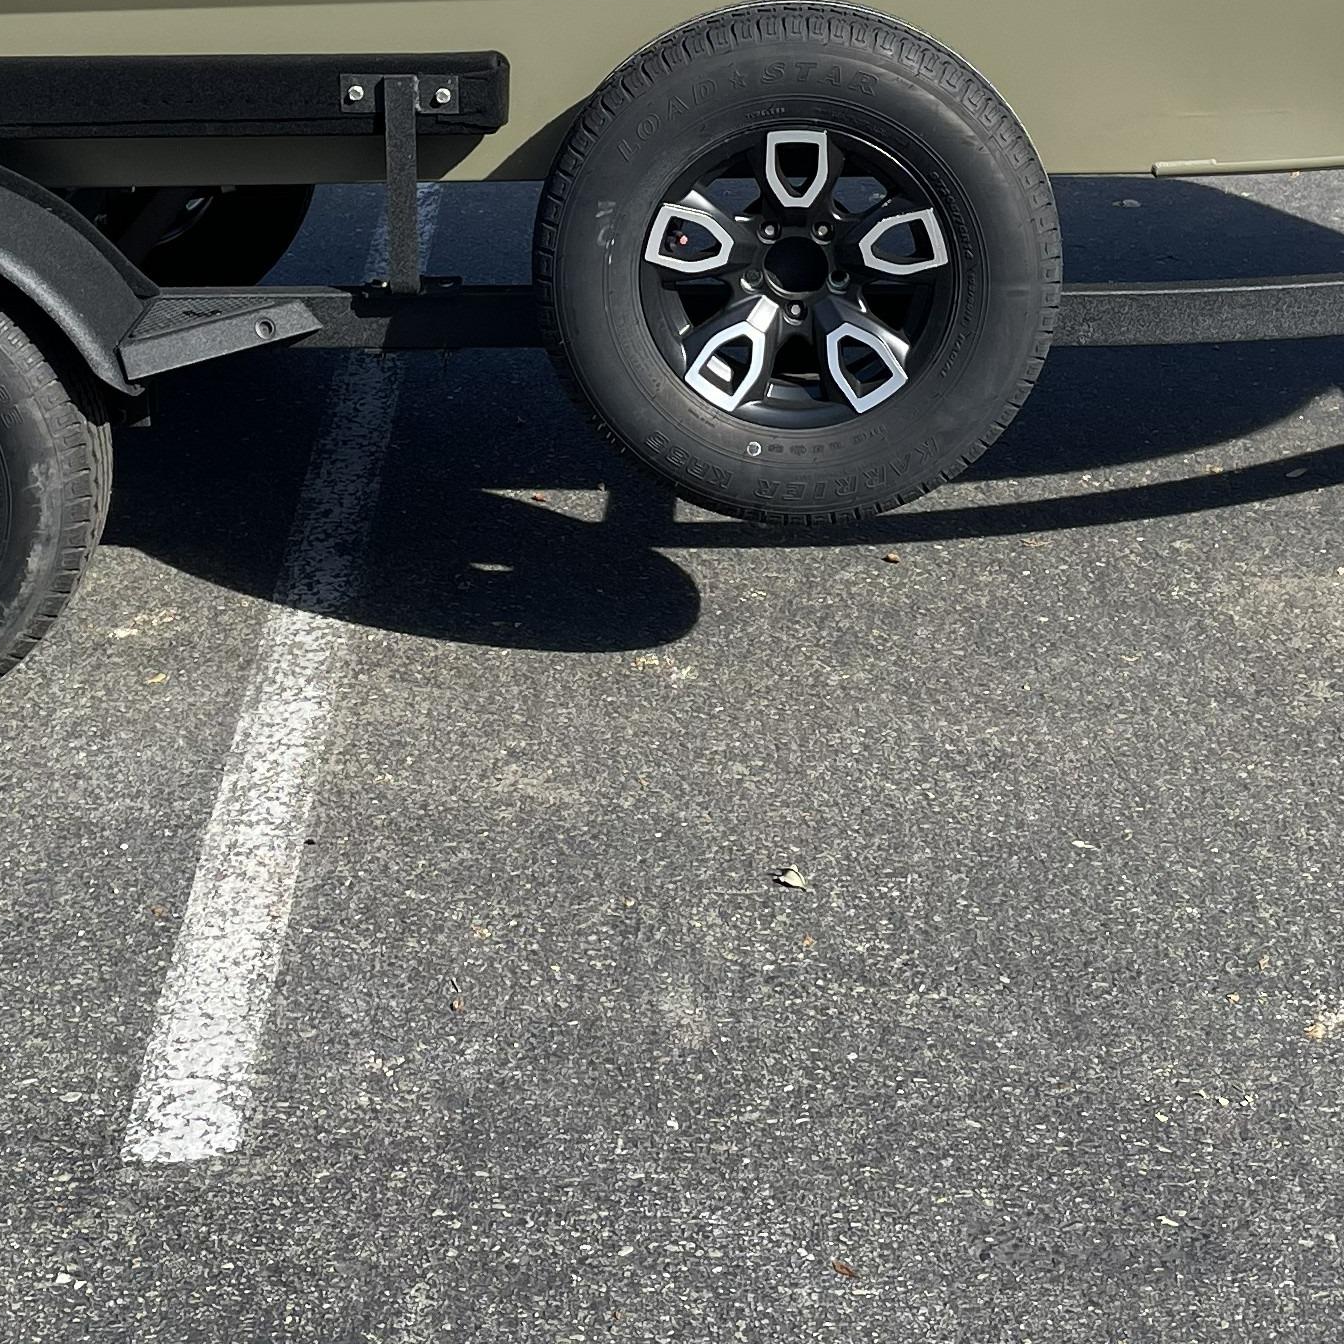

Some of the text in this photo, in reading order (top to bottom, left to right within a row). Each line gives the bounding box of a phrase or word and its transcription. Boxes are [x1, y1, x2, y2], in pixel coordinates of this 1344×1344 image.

[616, 62, 881, 162] LOAD STAR
[753, 435, 941, 500] KARRIER
